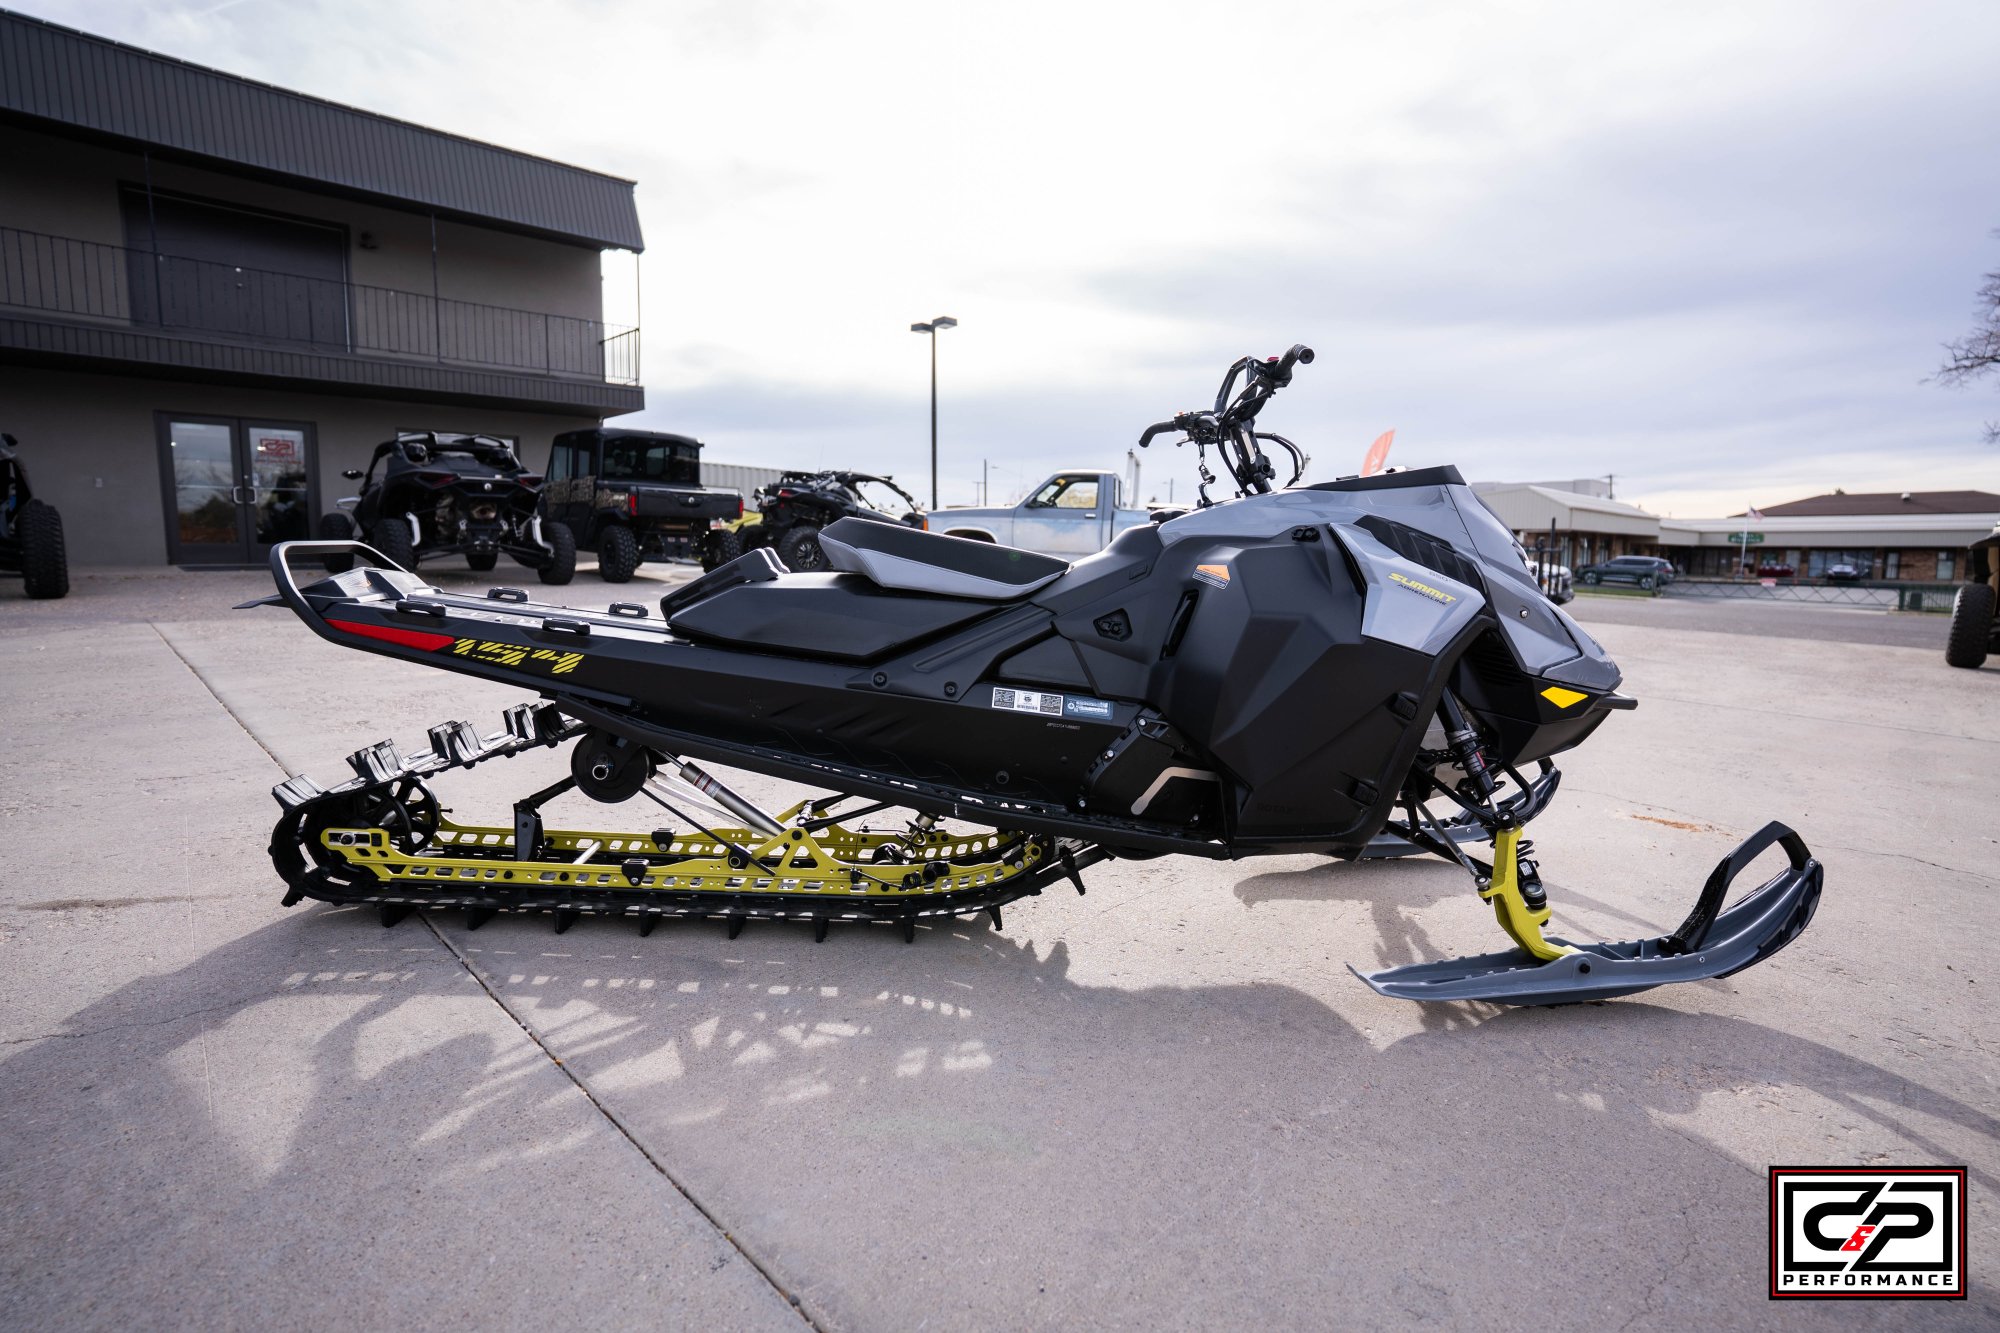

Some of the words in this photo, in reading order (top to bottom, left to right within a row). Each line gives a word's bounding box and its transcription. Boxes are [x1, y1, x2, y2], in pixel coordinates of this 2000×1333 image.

[1388, 572, 1457, 602] SUMMIT
[1397, 583, 1447, 606] ADRENALINE
[453, 638, 585, 674] 154
